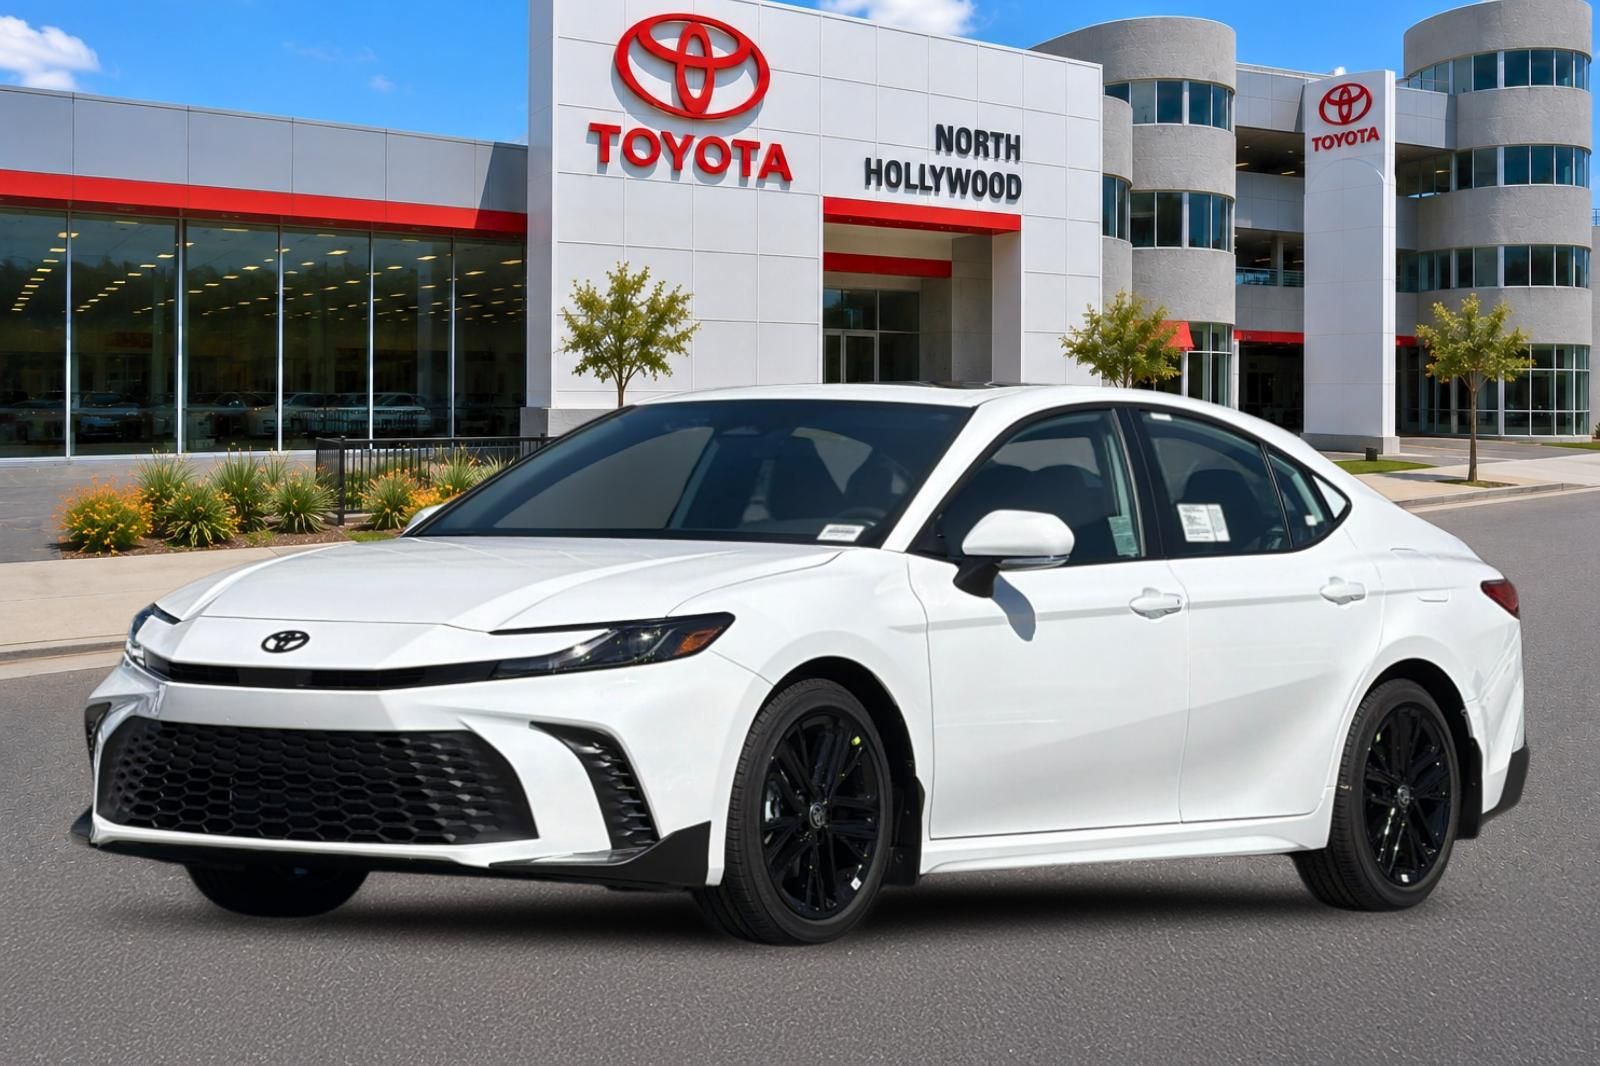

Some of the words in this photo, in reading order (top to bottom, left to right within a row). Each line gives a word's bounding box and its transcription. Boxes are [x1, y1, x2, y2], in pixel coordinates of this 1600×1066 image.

[589, 122, 793, 182] TOYOTA
[935, 124, 1021, 161] NORTH
[1311, 126, 1380, 152] TOYOTA
[864, 158, 1022, 200] HOLLYWOOD
